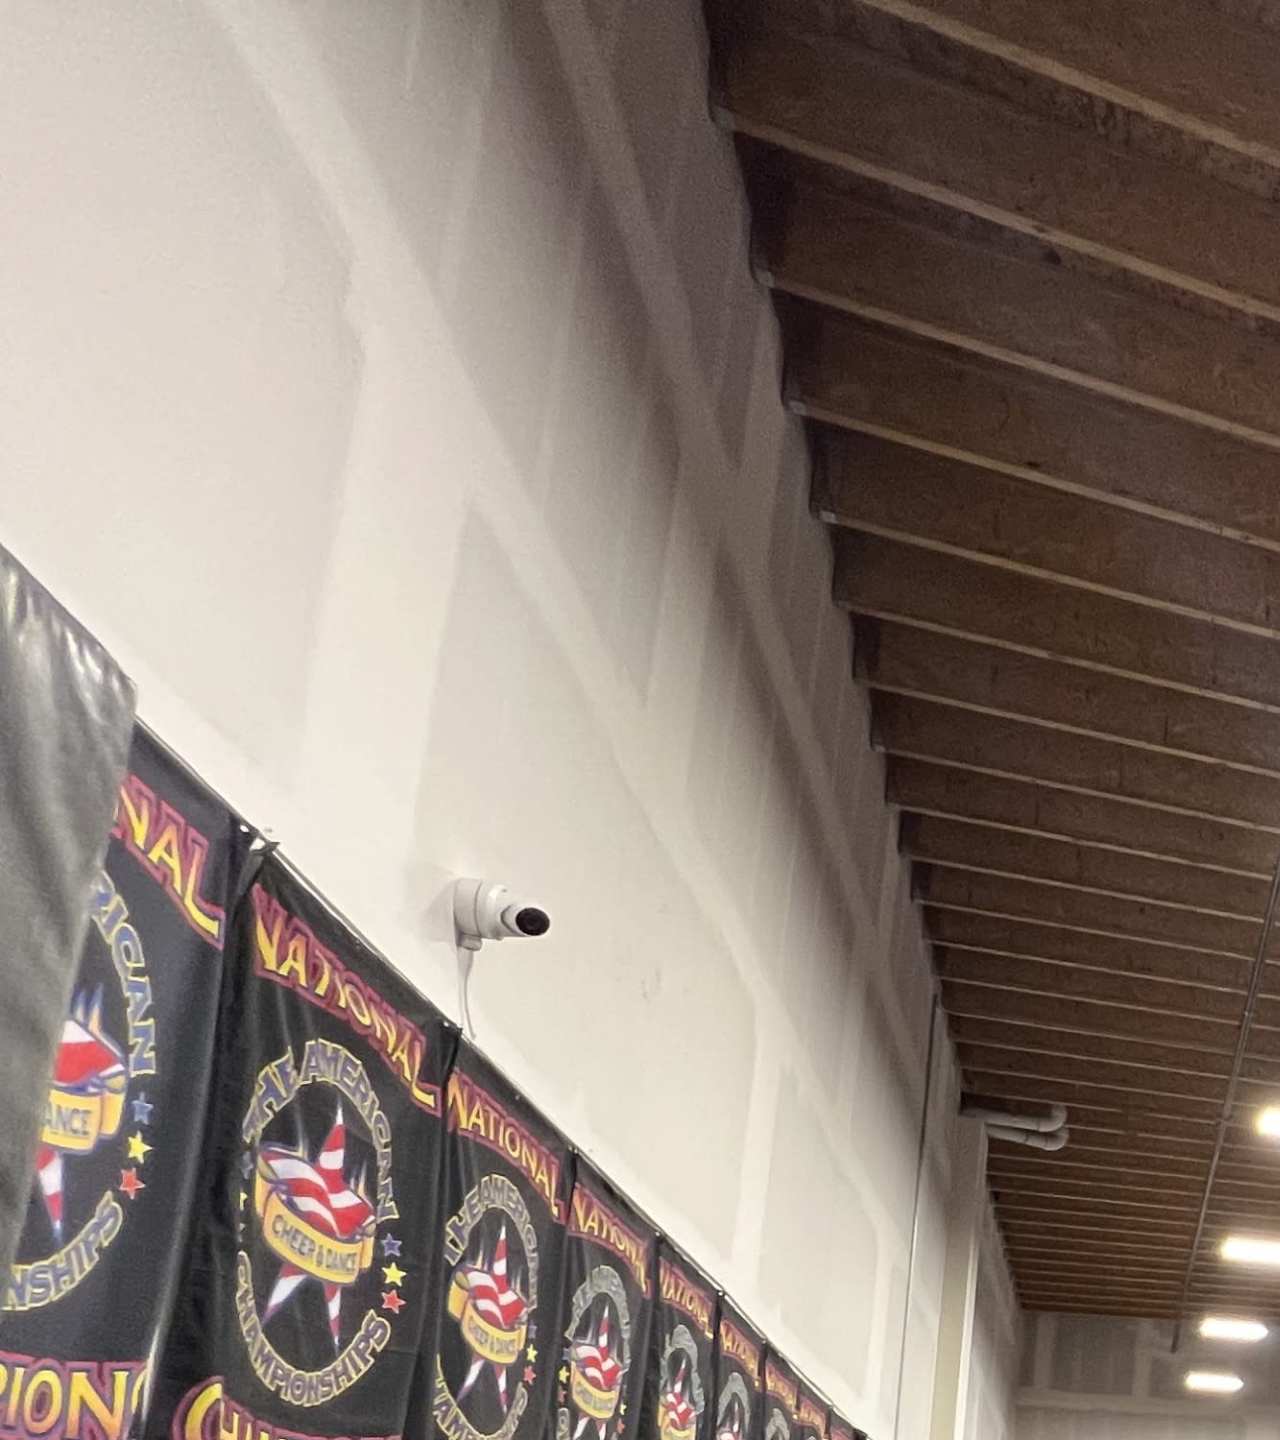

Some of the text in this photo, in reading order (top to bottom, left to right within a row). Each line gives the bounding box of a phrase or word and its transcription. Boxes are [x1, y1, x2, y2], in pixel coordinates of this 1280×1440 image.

[252, 884, 440, 1115] NATIONAL
[42, 1102, 94, 1138] ANCE
[448, 1068, 569, 1225] NATIONAL
